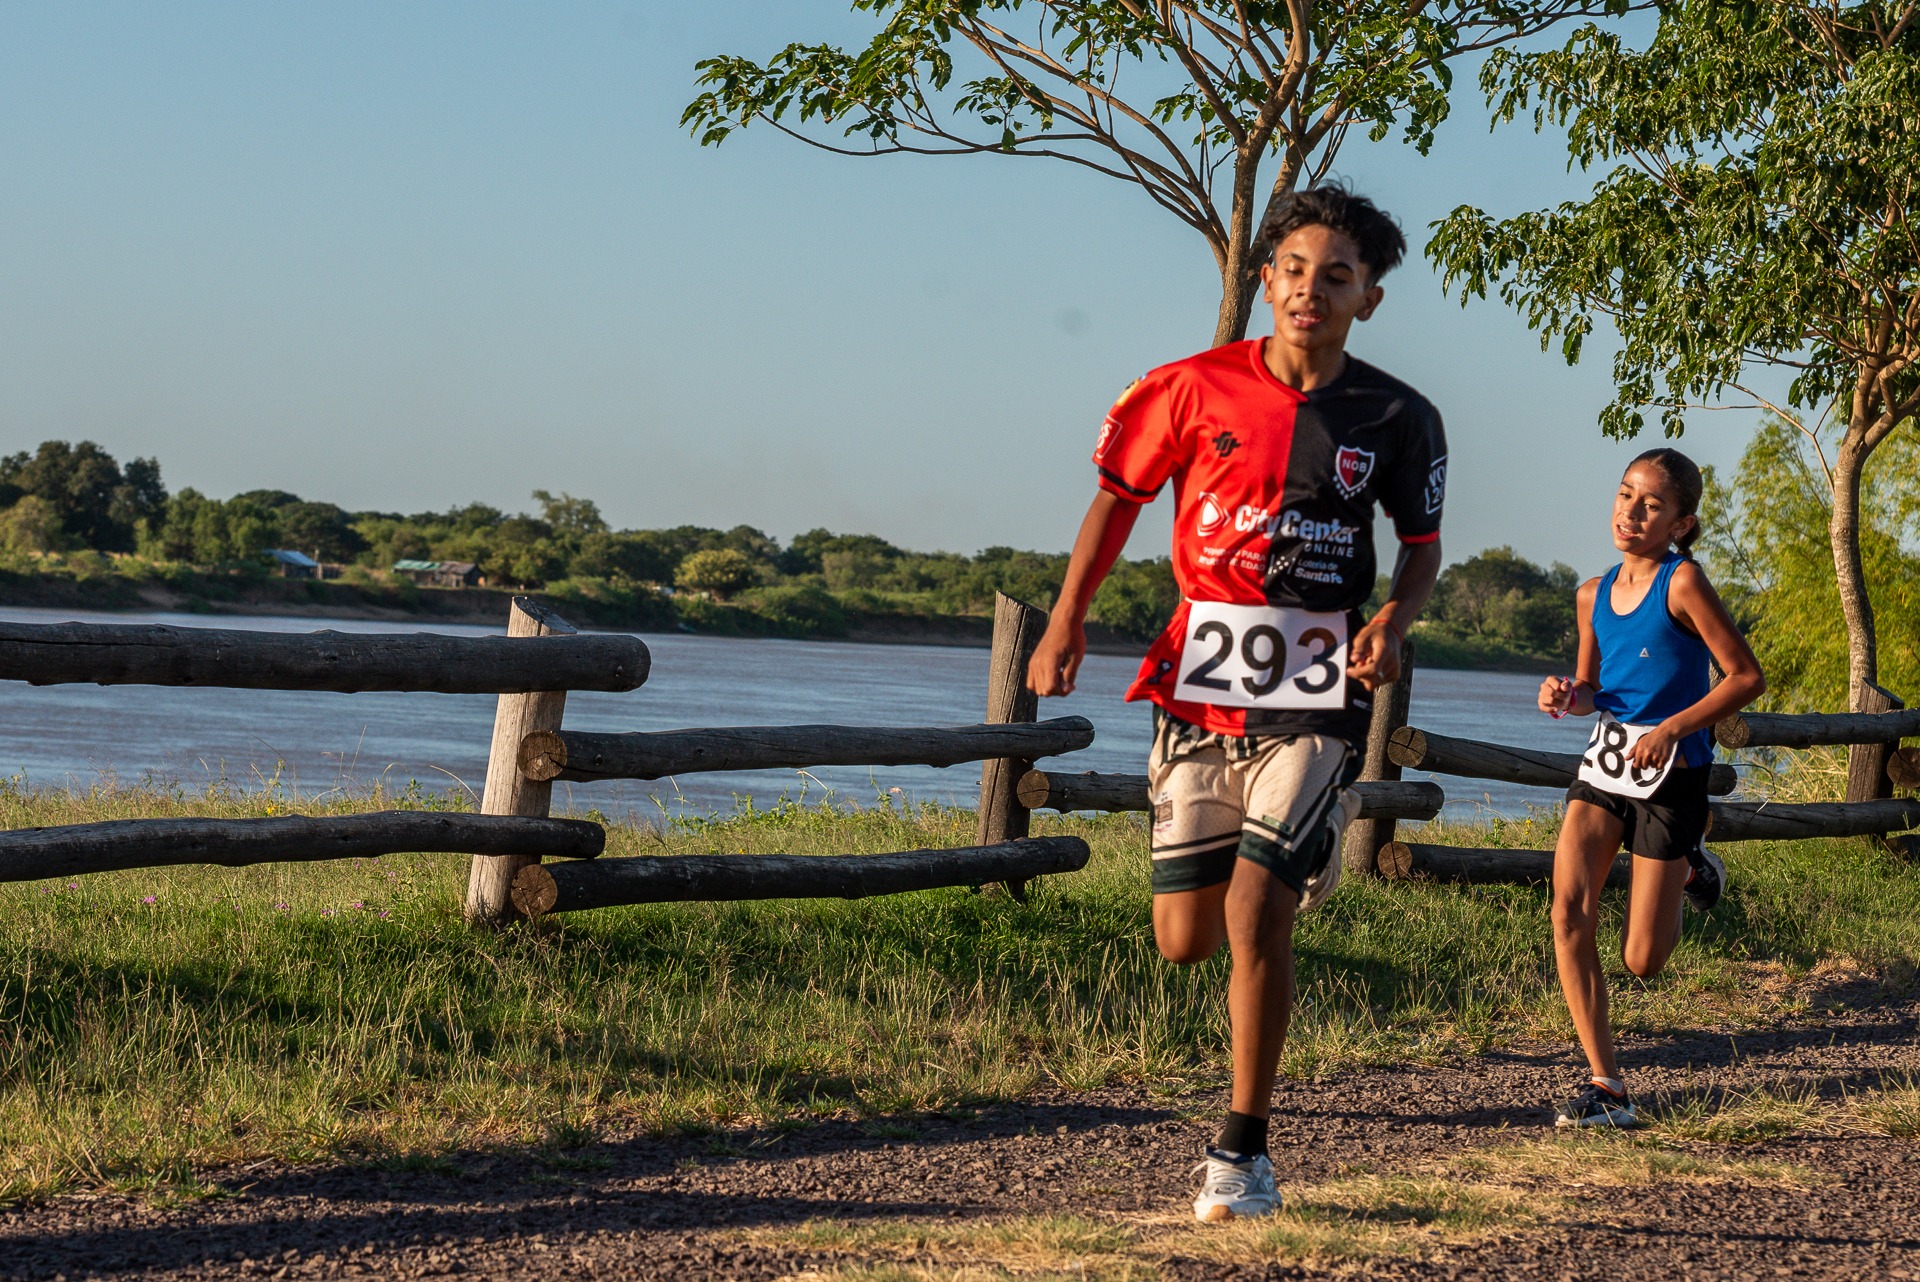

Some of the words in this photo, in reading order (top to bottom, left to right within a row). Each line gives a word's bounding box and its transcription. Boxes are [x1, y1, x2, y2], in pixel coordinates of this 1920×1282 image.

[1342, 458, 1367, 473] NOB
[1304, 543, 1354, 558] ONLINE
[1183, 620, 1340, 697] 293
